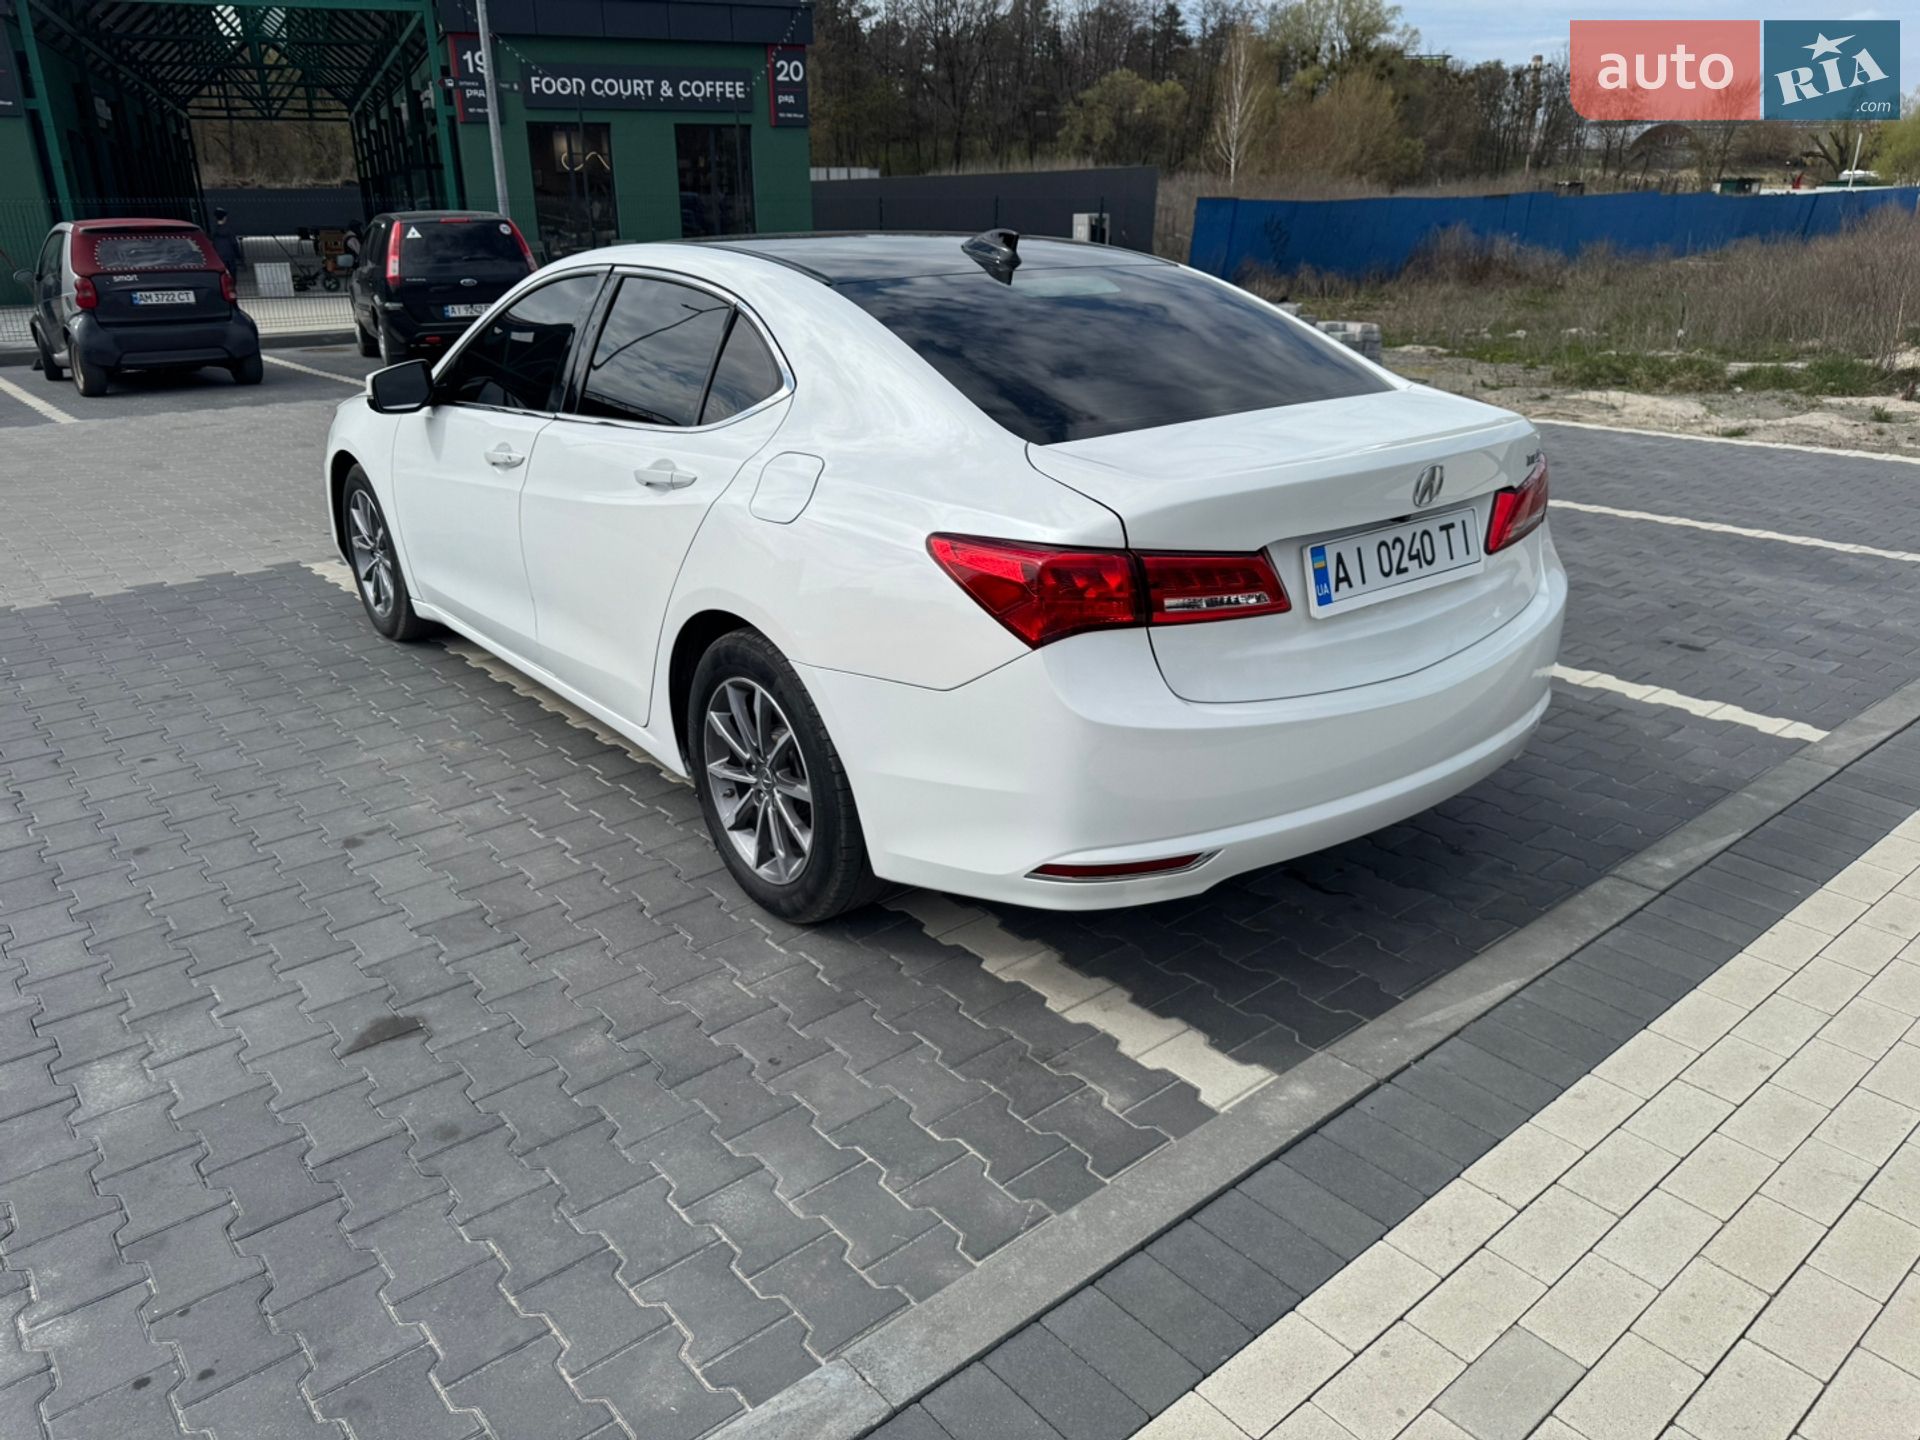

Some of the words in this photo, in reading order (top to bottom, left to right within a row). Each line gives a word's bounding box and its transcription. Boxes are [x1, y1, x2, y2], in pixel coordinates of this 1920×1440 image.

[776, 60, 804, 81] 20
[530, 76, 586, 95] FOOD
[591, 78, 655, 96] COURT
[660, 80, 674, 97] &
[679, 80, 745, 98] COFFEE
[112, 274, 139, 282] smart
[154, 293, 177, 302] 3722
[1334, 546, 1367, 593] AI
[1376, 529, 1435, 578] 0240
[1439, 519, 1471, 560] TI
[1316, 582, 1330, 596] UA
